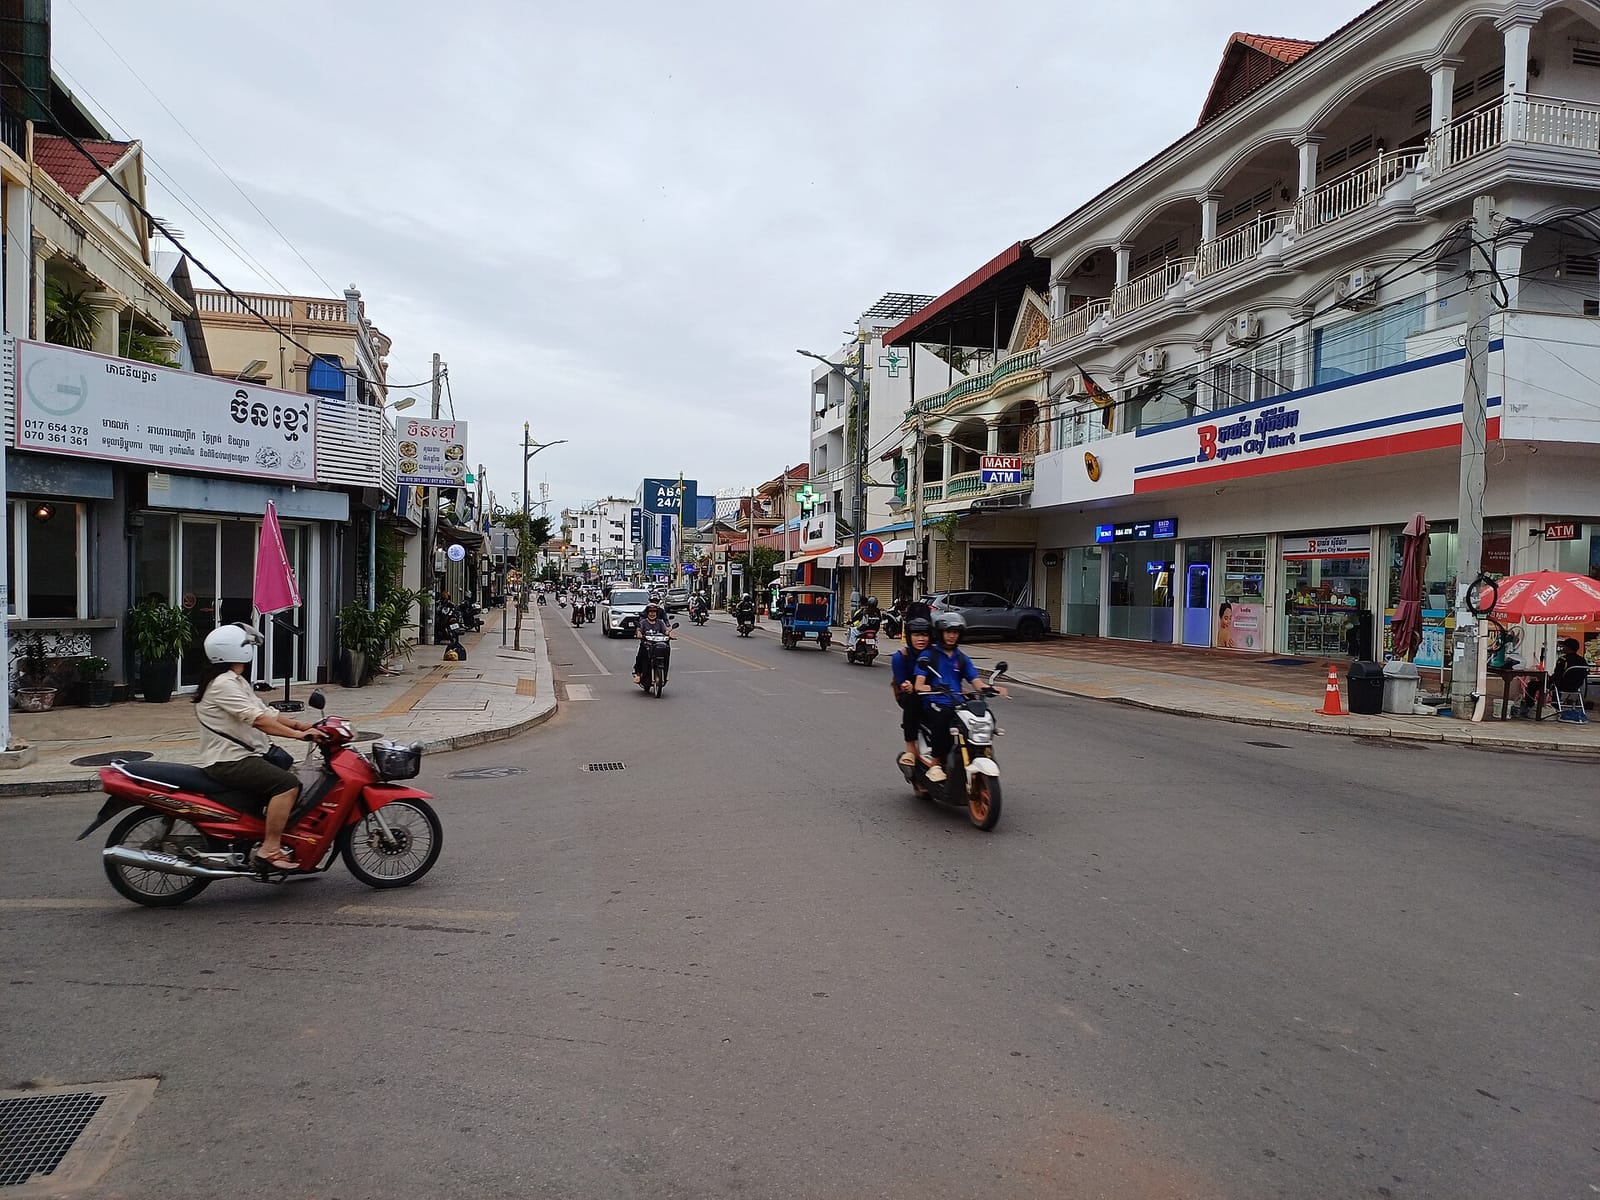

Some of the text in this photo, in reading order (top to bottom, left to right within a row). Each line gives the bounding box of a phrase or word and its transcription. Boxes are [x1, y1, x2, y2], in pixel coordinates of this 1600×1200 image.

[24, 420, 88, 435] 017 654 378
[24, 430, 88, 446] 070 361 361
[1244, 439, 1266, 454] City
[1268, 432, 1296, 448] Mart
[985, 456, 1018, 468] MART
[989, 472, 1014, 482] ATM
[657, 498, 681, 507] 24/7
[1546, 525, 1574, 536] ATM
